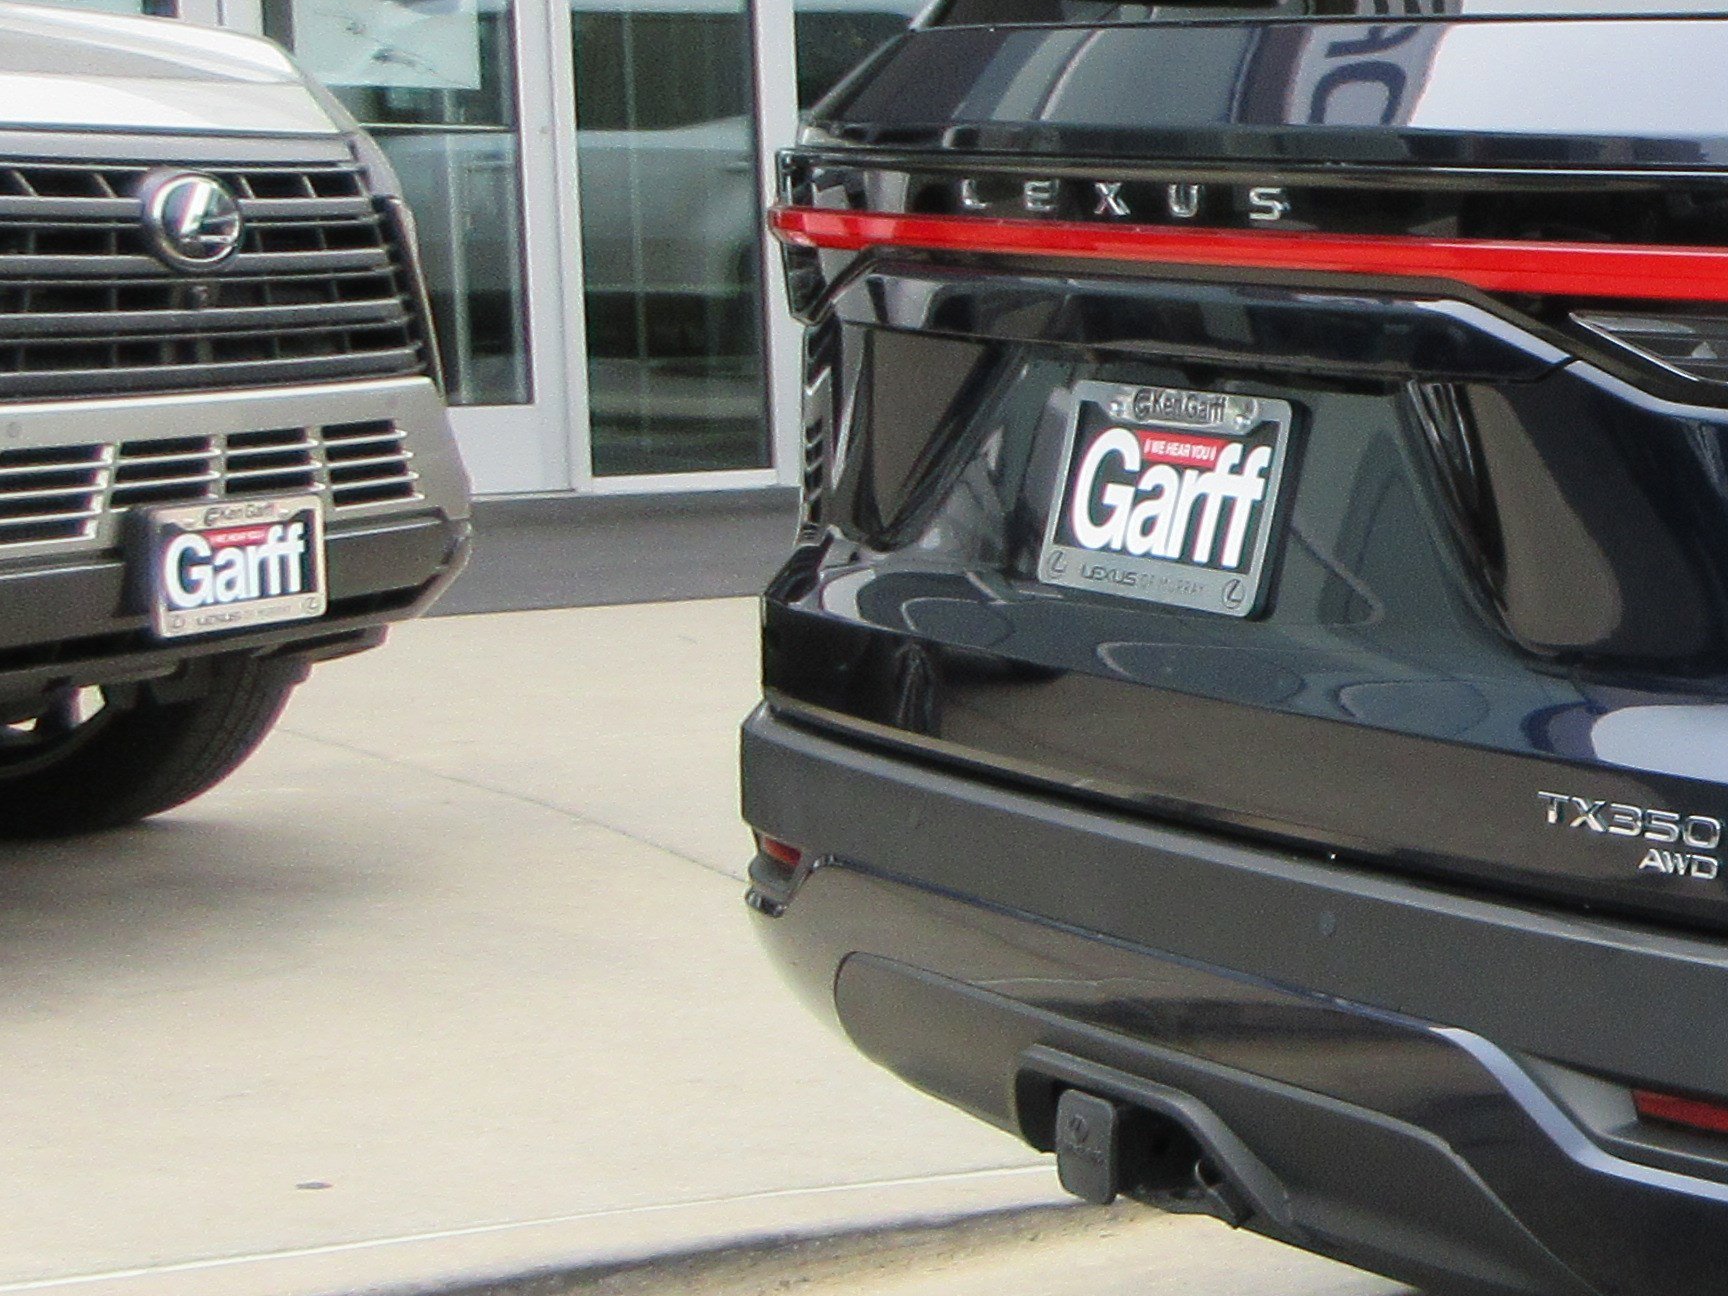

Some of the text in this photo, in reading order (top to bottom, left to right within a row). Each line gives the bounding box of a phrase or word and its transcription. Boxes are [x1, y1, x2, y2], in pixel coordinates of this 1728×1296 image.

[960, 178, 1288, 221] LEXUS
[1166, 441, 1191, 457] HEAR
[1191, 445, 1211, 460] YOU
[1072, 427, 1272, 569] Garff
[165, 521, 305, 608] Garff
[1080, 563, 1138, 587] LEXUS
[1537, 790, 1722, 850] TX350
[1638, 848, 1719, 880] AWD
